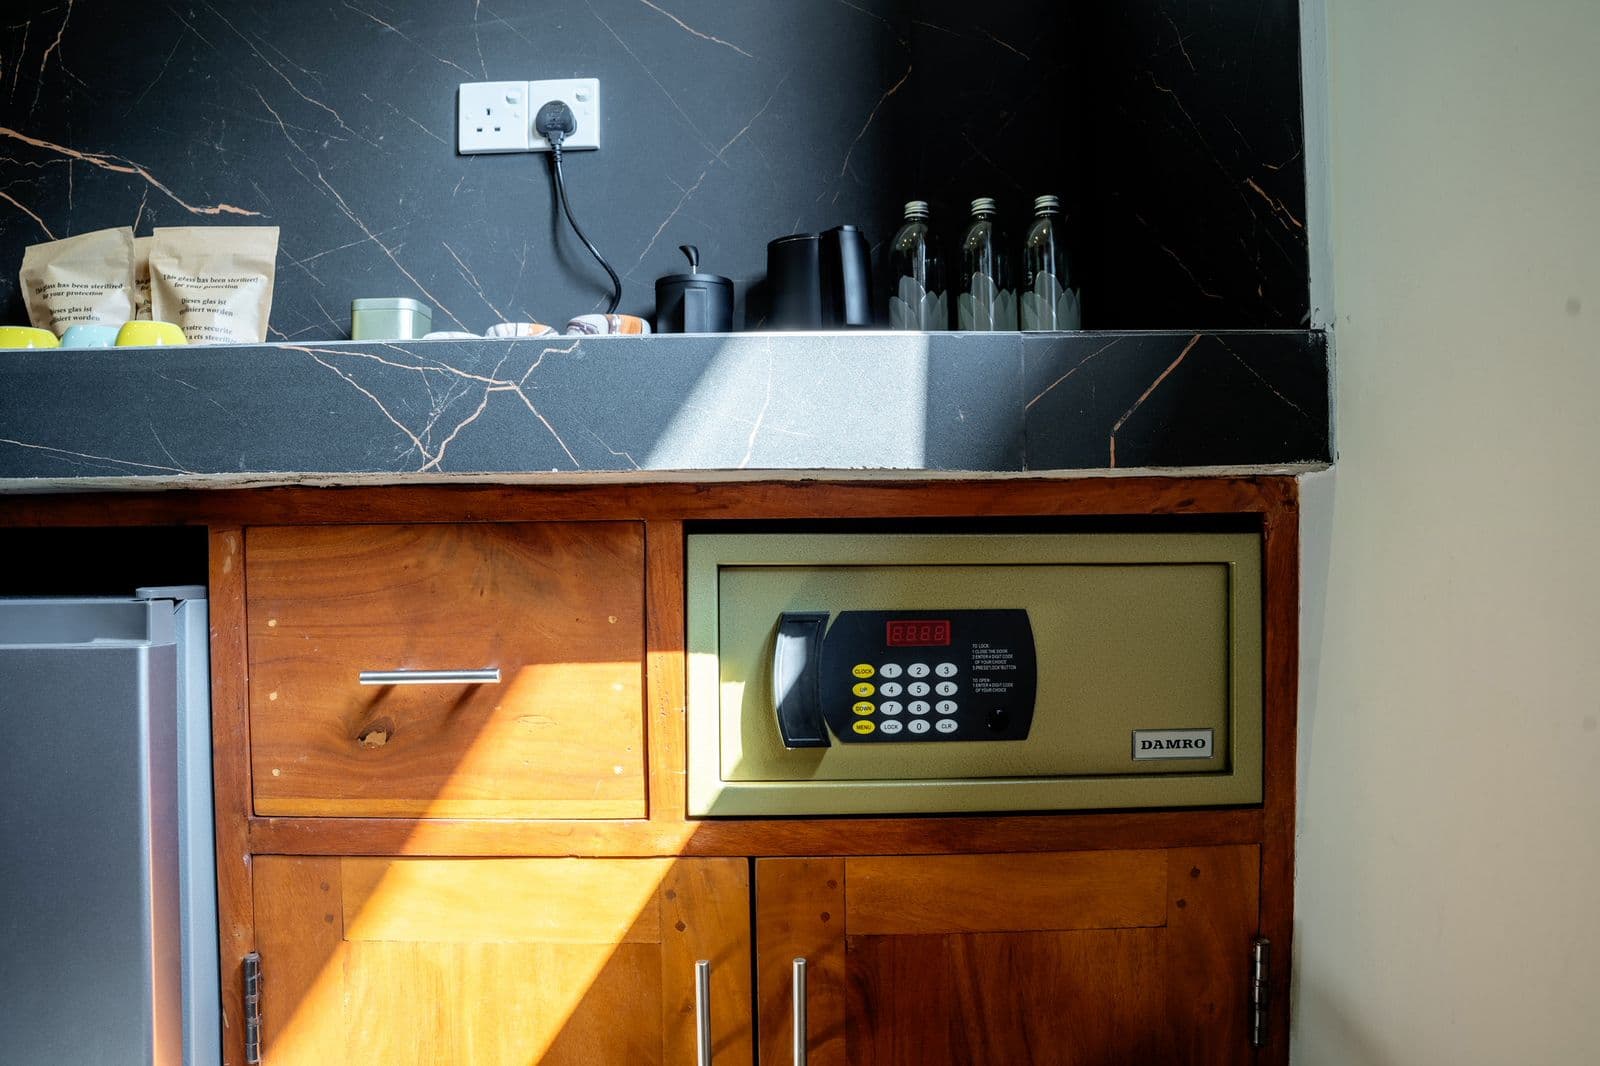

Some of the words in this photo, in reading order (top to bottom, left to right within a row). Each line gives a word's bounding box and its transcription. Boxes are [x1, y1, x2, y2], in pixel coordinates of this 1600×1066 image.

[68, 306, 82, 314] glas
[888, 667, 893, 675] 1
[916, 667, 922, 675] 2
[943, 666, 950, 675] 3
[888, 685, 894, 693] 4
[916, 685, 922, 693] 5
[943, 685, 950, 693] 6
[888, 704, 894, 712] 7
[916, 704, 922, 712] 8
[943, 703, 950, 711] 9
[915, 722, 922, 731] 0
[1140, 739, 1206, 750] DAMRO
